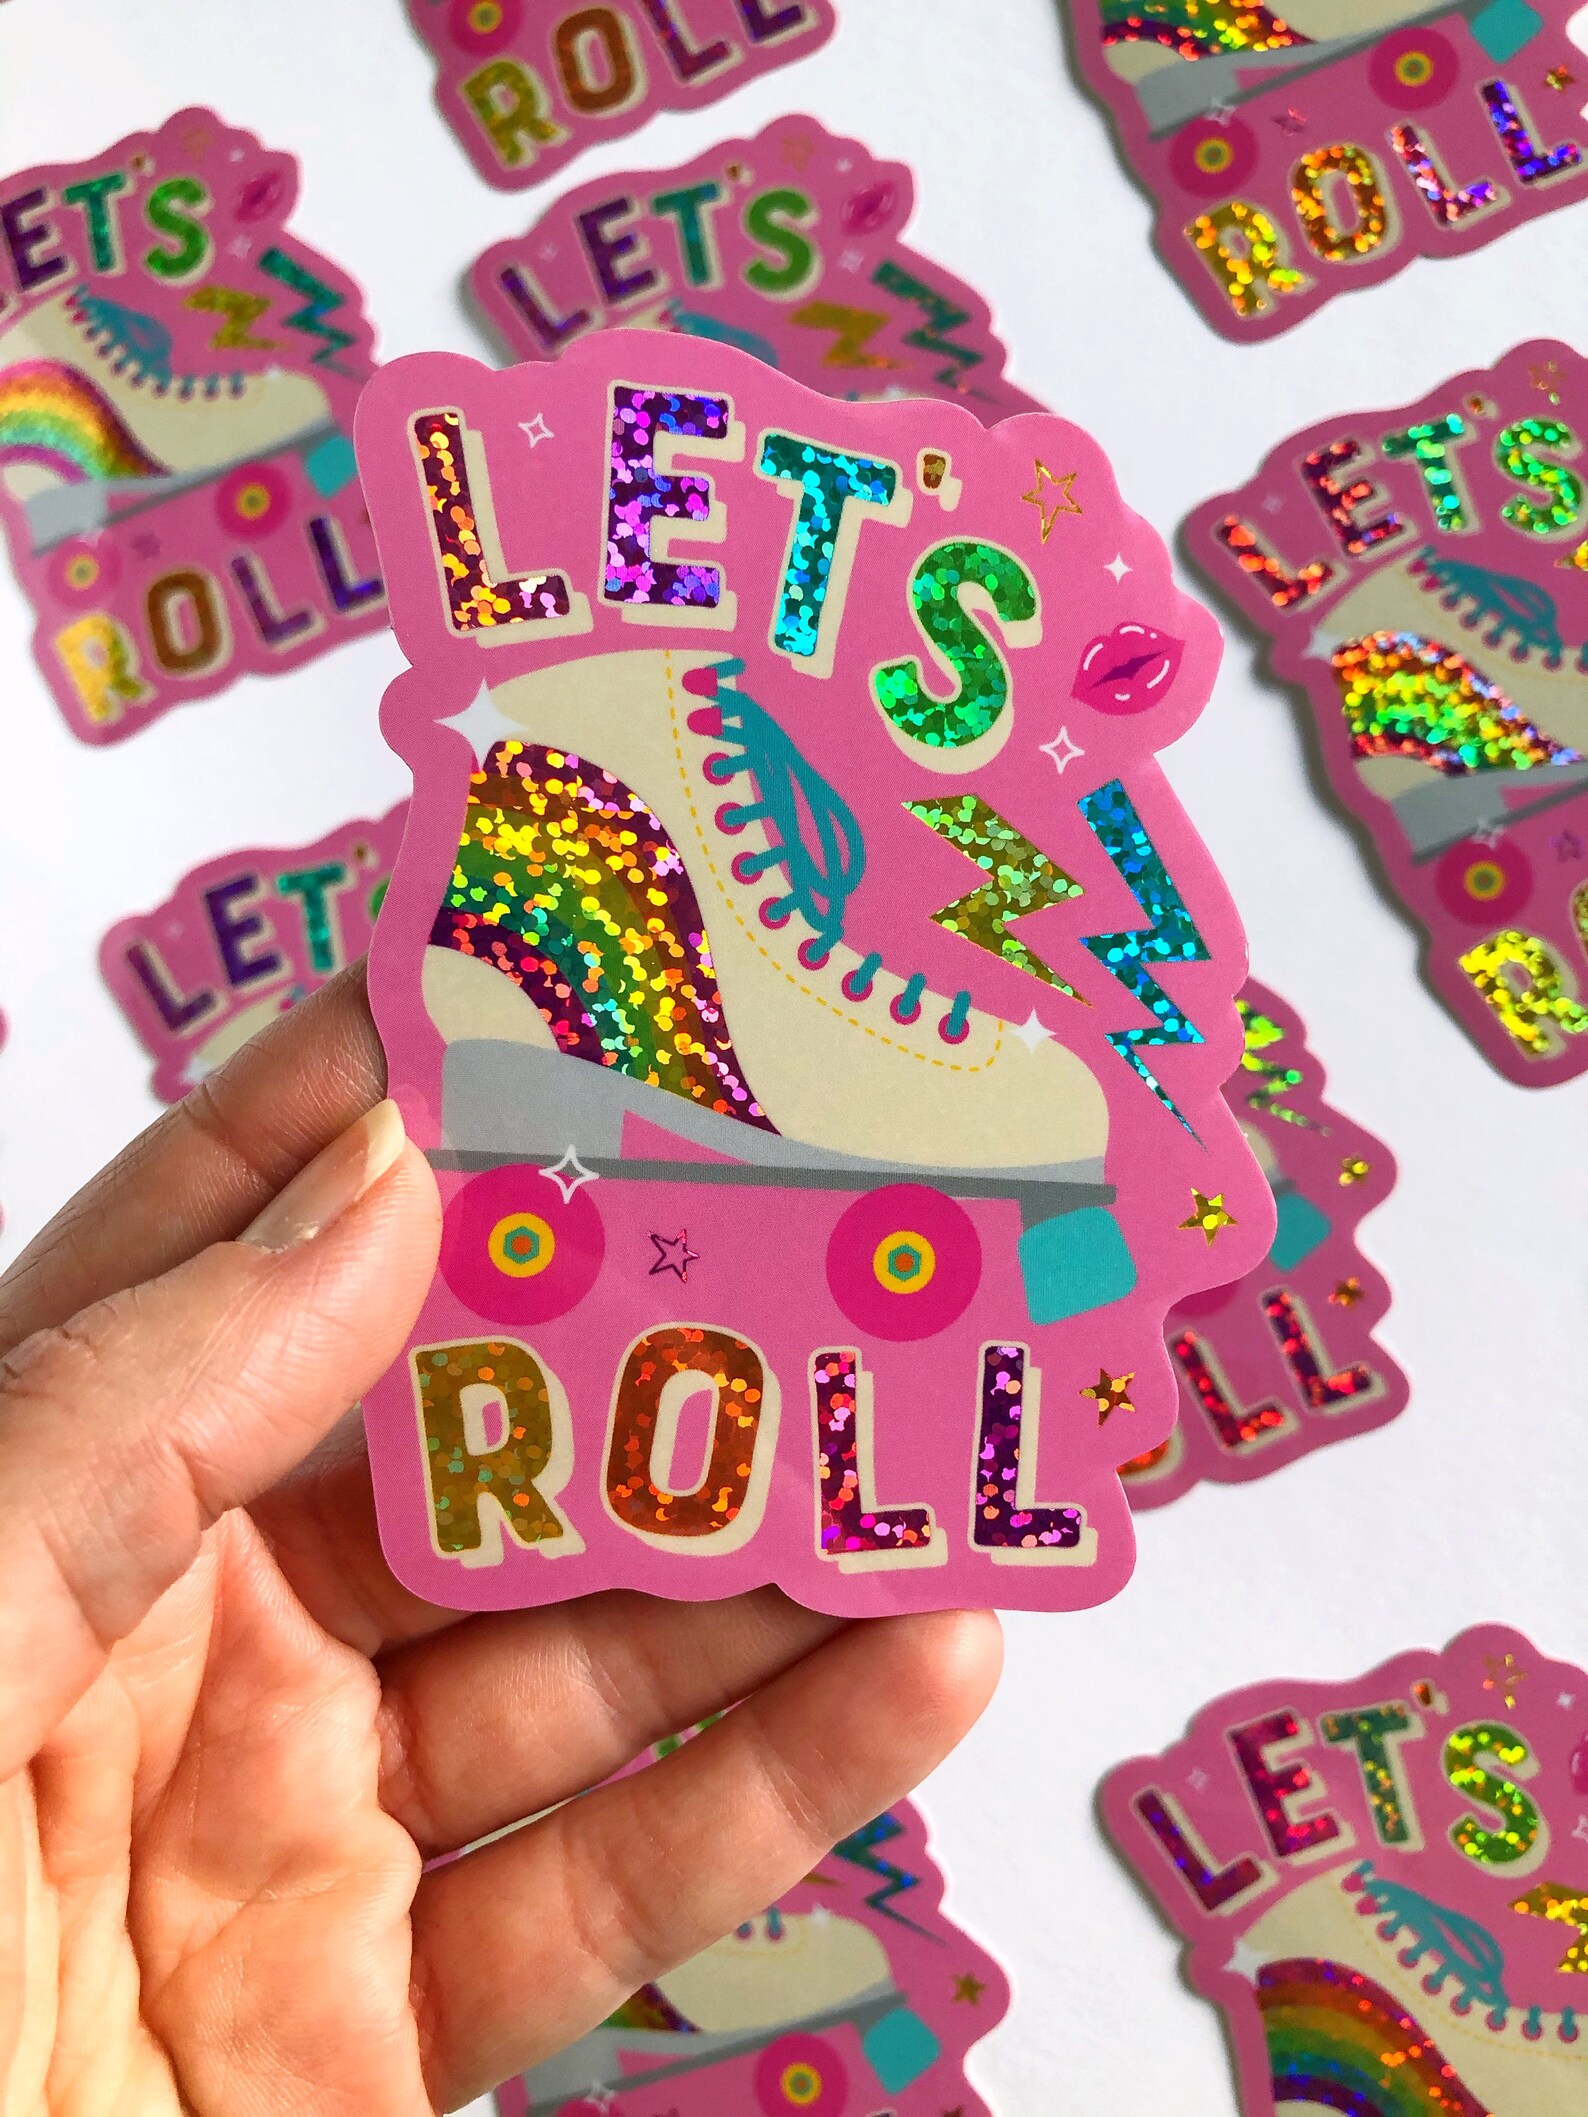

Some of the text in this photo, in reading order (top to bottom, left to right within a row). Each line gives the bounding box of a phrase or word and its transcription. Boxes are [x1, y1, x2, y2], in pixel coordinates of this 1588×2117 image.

[0, 155, 215, 318] ET'S
[497, 162, 823, 348] LET'S
[1184, 80, 1584, 317] ROLL
[407, 378, 1043, 775] LET'S
[1212, 394, 1588, 614] LET'S
[55, 514, 388, 725] ROLL
[124, 843, 398, 1037] LET'
[408, 1320, 1098, 1573] ROLL
[1130, 1678, 1549, 1915] LET'S
